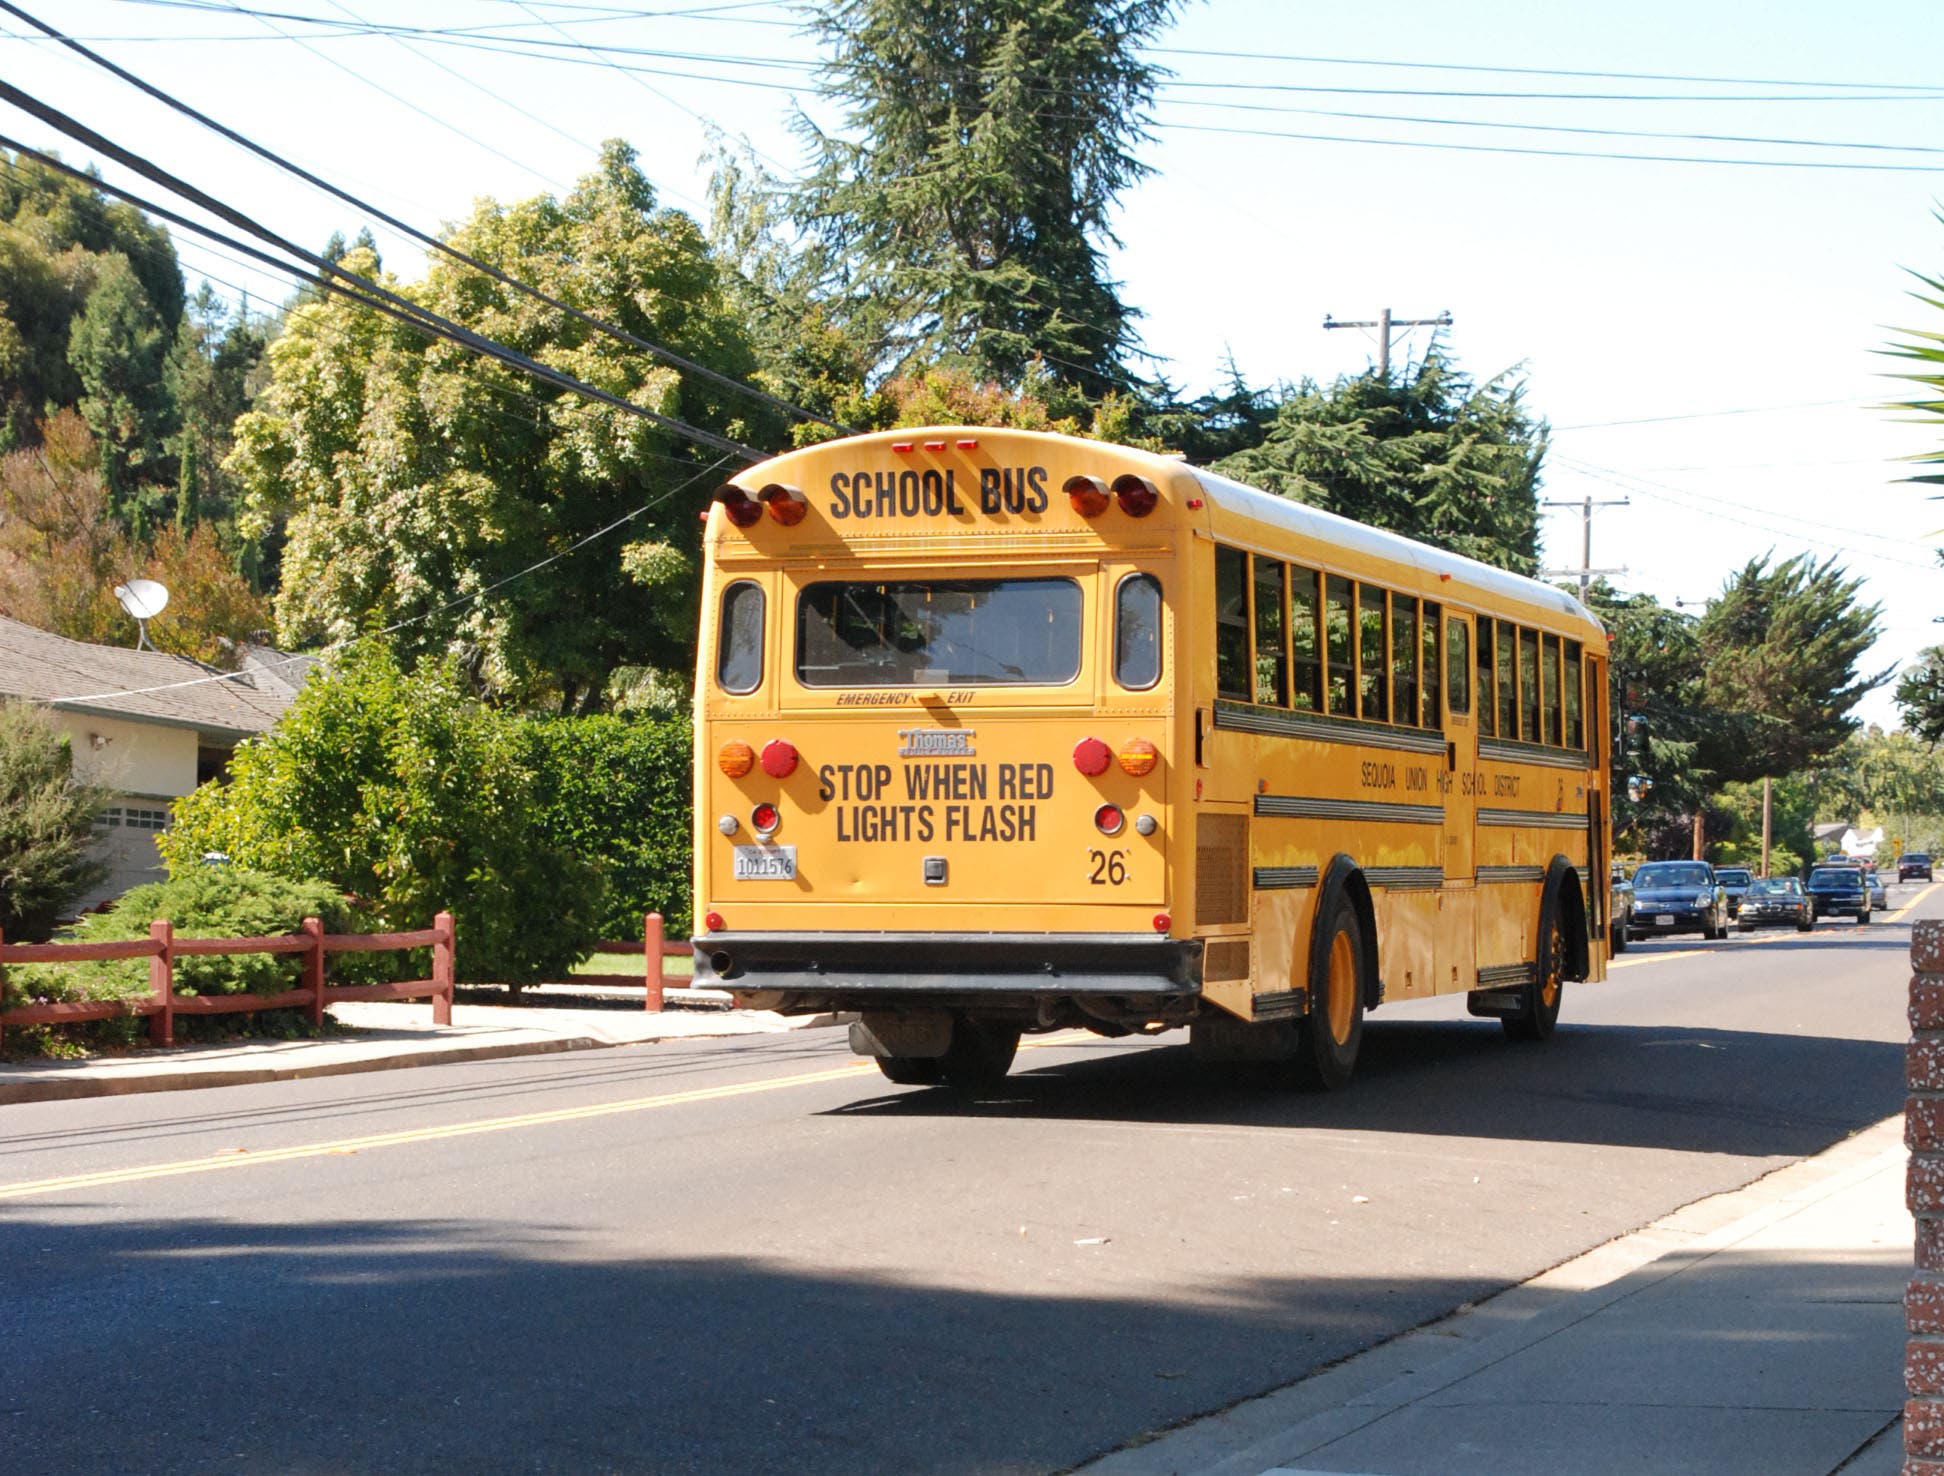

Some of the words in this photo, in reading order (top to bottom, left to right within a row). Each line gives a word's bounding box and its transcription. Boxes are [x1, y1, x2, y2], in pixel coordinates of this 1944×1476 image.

[831, 469, 963, 519] SCHOOL
[981, 467, 1048, 514] BUS
[836, 692, 911, 706] EMERGENCY
[947, 691, 976, 704] EXIT
[905, 728, 967, 749] Thomas
[819, 765, 892, 801] STOP
[905, 764, 988, 800] WHEN
[999, 763, 1054, 799] RED
[1361, 761, 1396, 790] SEQUOIA
[1405, 767, 1428, 792] UNION
[1436, 769, 1453, 794] HIGH
[836, 806, 934, 842] LIGHTS
[945, 805, 1036, 842] FLASH
[738, 858, 792, 875] 1011576
[1091, 850, 1126, 885] 26
